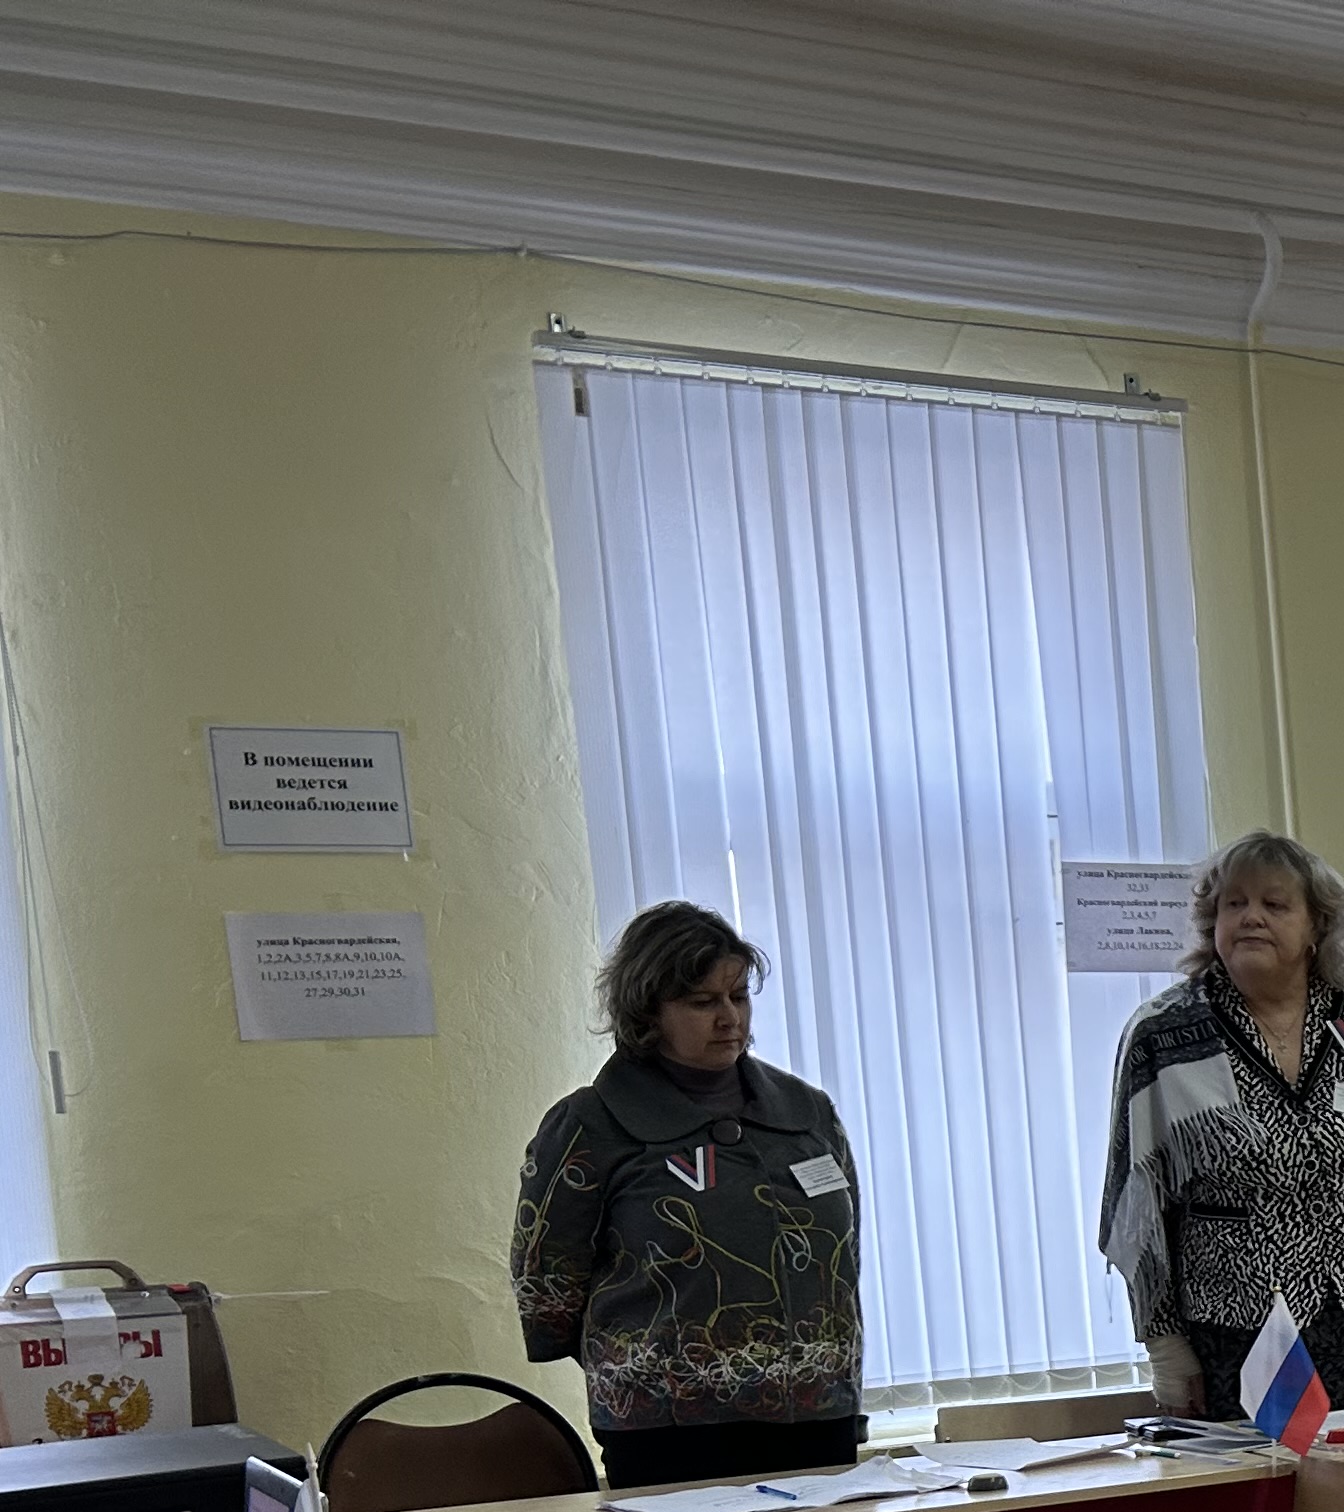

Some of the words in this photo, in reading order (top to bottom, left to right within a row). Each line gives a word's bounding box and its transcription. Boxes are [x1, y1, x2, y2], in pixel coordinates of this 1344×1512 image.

[244, 751, 257, 767] В
[264, 754, 374, 770] помещении
[276, 776, 349, 791] ведется
[228, 796, 400, 813] видеонаблюдение
[1076, 870, 1105, 879] улица
[1127, 883, 1149, 893] 32,33
[1107, 928, 1135, 936] улица
[256, 938, 290, 948] улица
[292, 935, 401, 948] Красногвардейская,
[305, 987, 365, 998] 27,29,30,31
